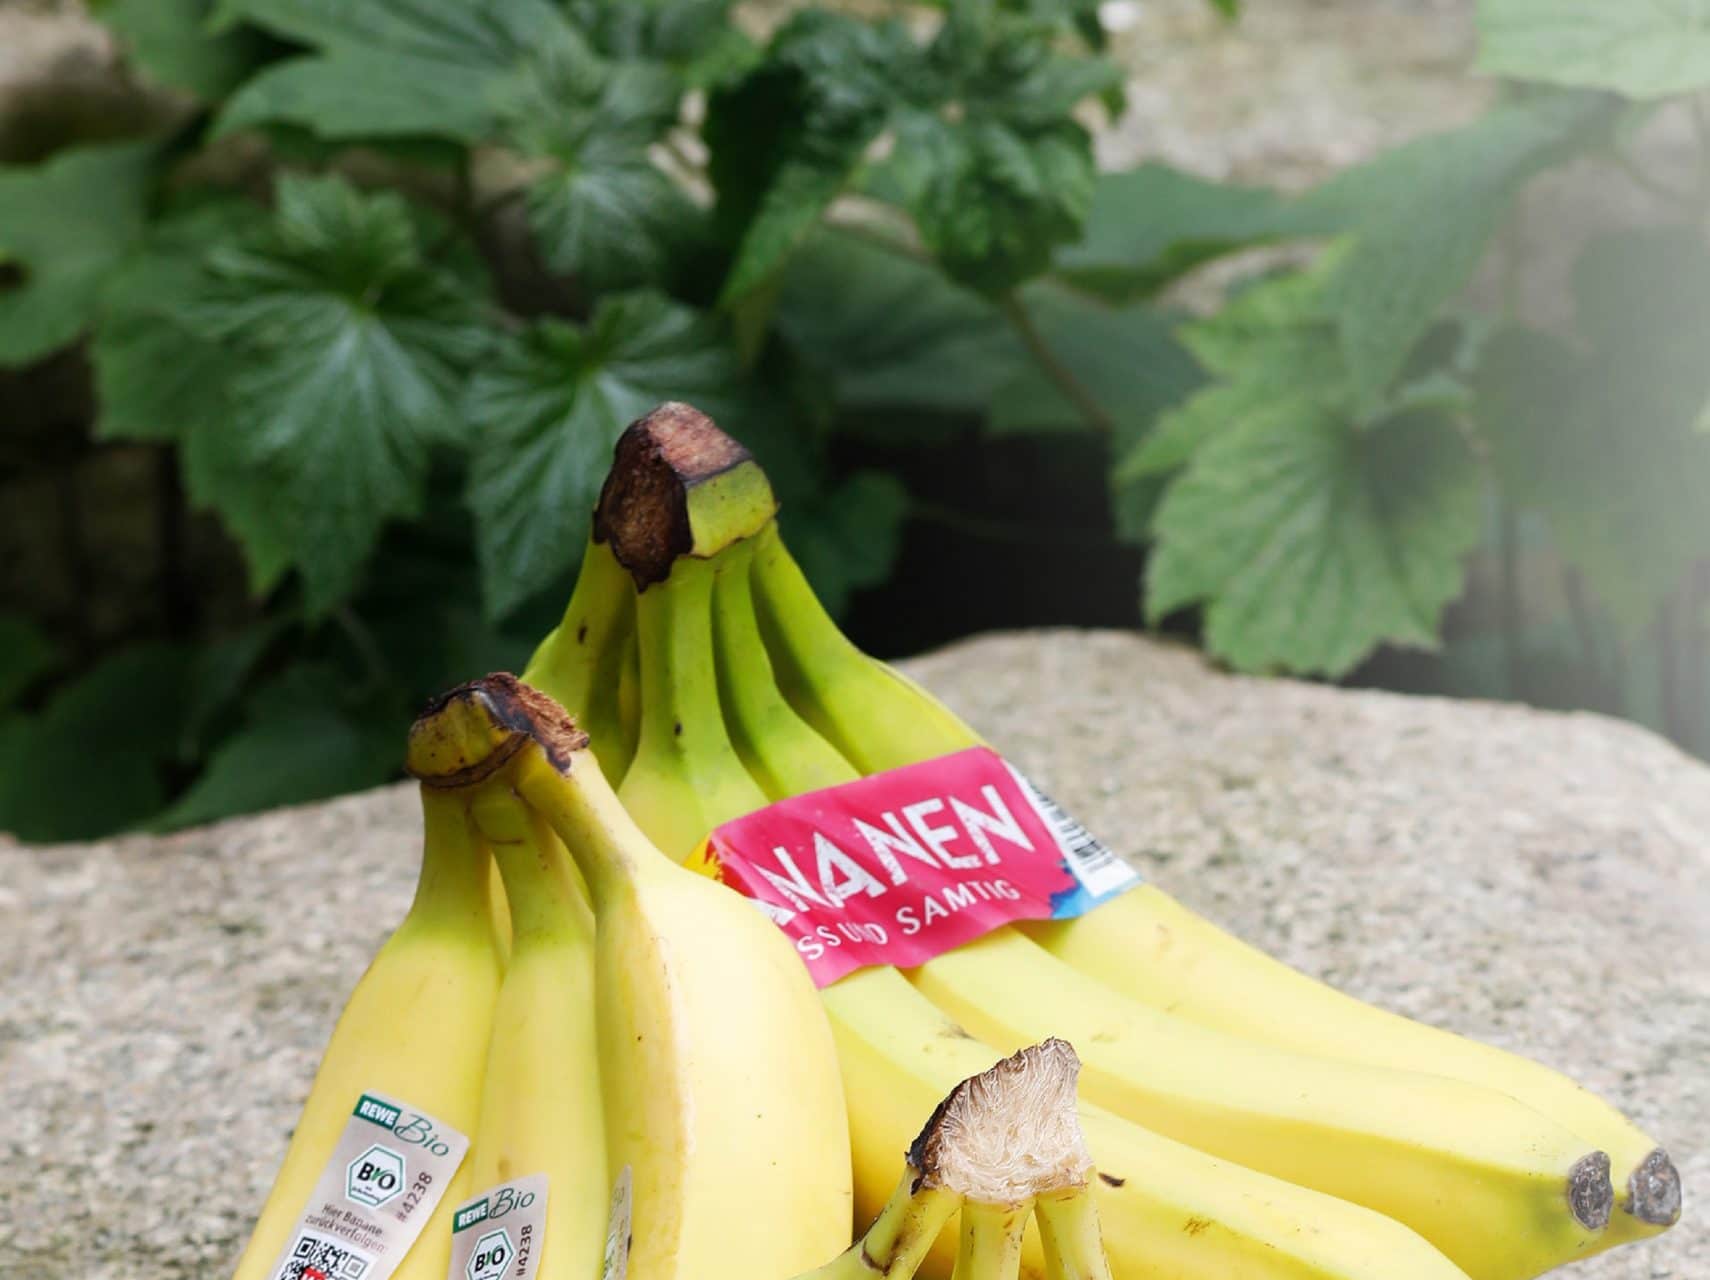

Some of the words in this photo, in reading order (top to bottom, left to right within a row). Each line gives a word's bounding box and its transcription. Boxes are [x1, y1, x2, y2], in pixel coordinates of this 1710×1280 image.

[896, 879, 1021, 936] SAMTIG
[360, 1101, 398, 1125] REWE
[394, 1114, 449, 1157] Bio
[357, 1162, 396, 1191] BIO
[397, 1171, 433, 1224] #4238
[458, 1203, 487, 1227] REWE
[489, 1187, 536, 1220] Bio
[341, 1209, 384, 1237] Banane
[474, 1247, 505, 1273] BIO
